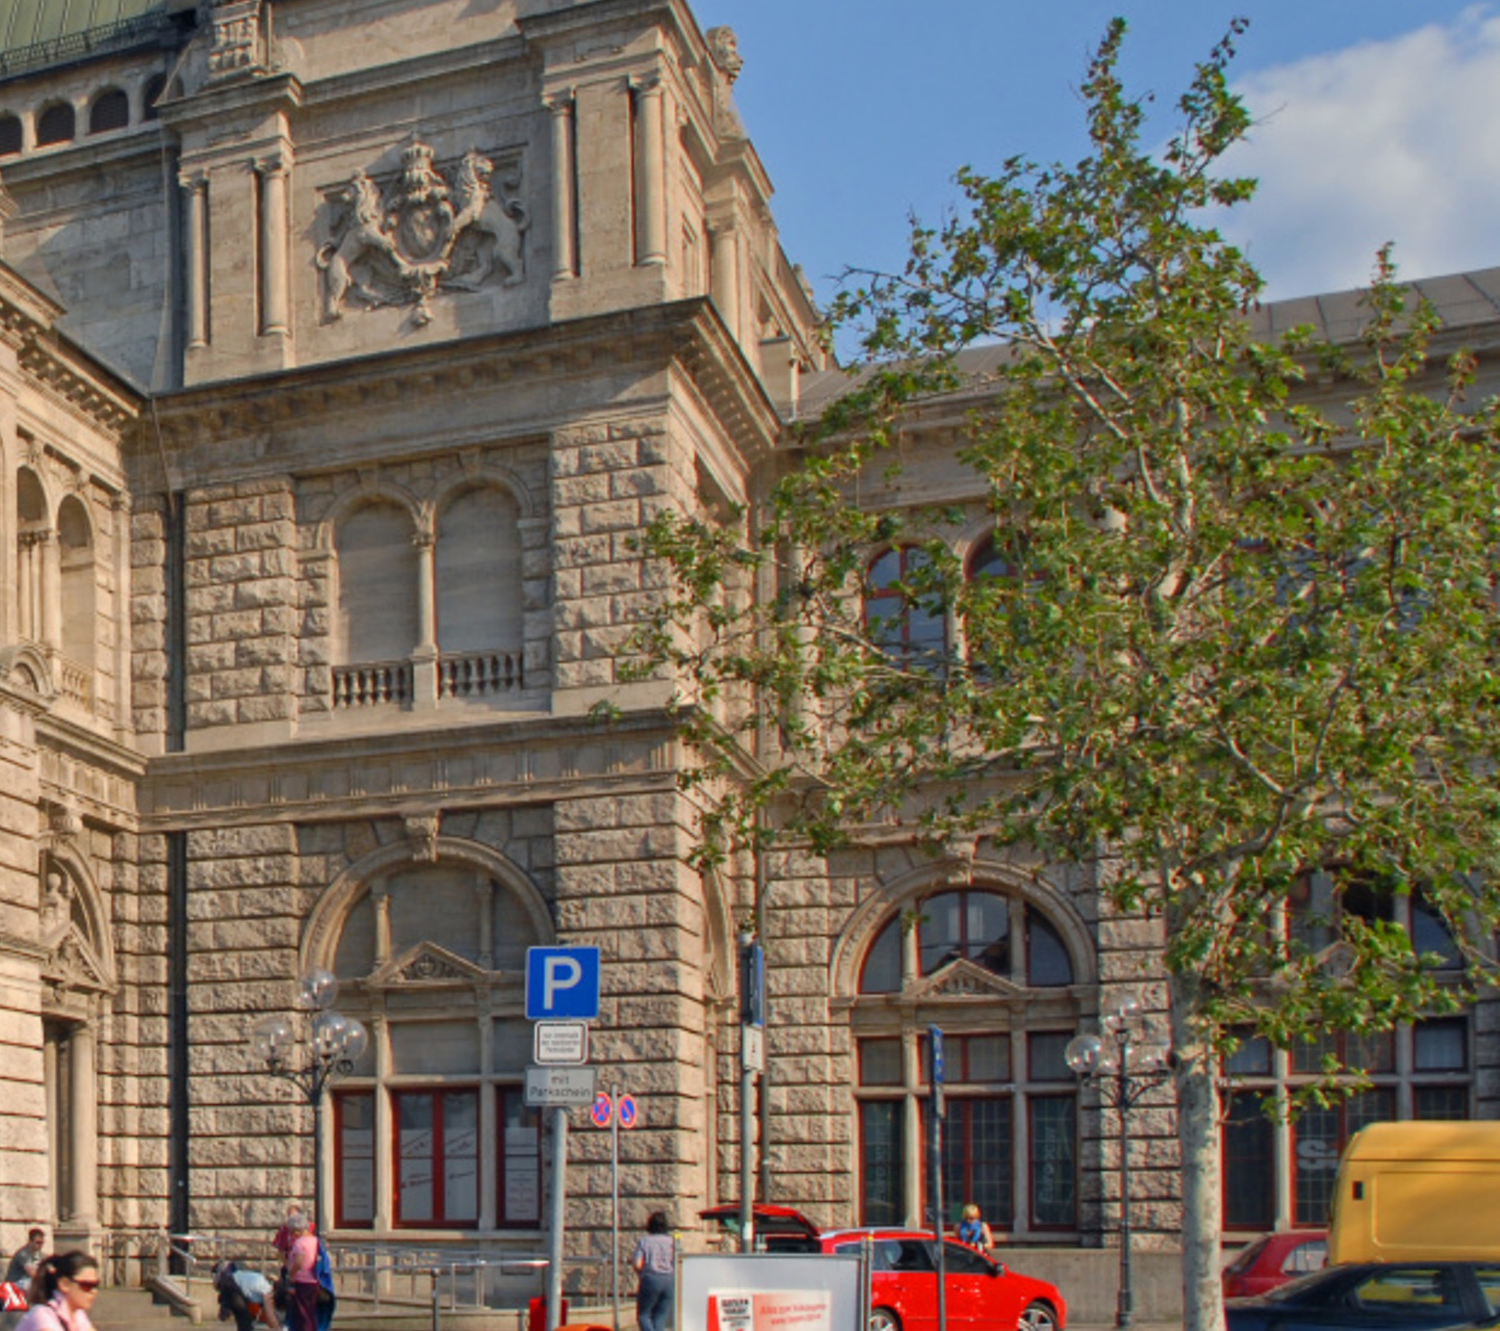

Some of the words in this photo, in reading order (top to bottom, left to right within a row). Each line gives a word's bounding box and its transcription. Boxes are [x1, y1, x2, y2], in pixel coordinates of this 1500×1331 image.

[544, 956, 582, 1010] P
[551, 1074, 570, 1085] mit
[530, 1086, 591, 1097] Parkschein
